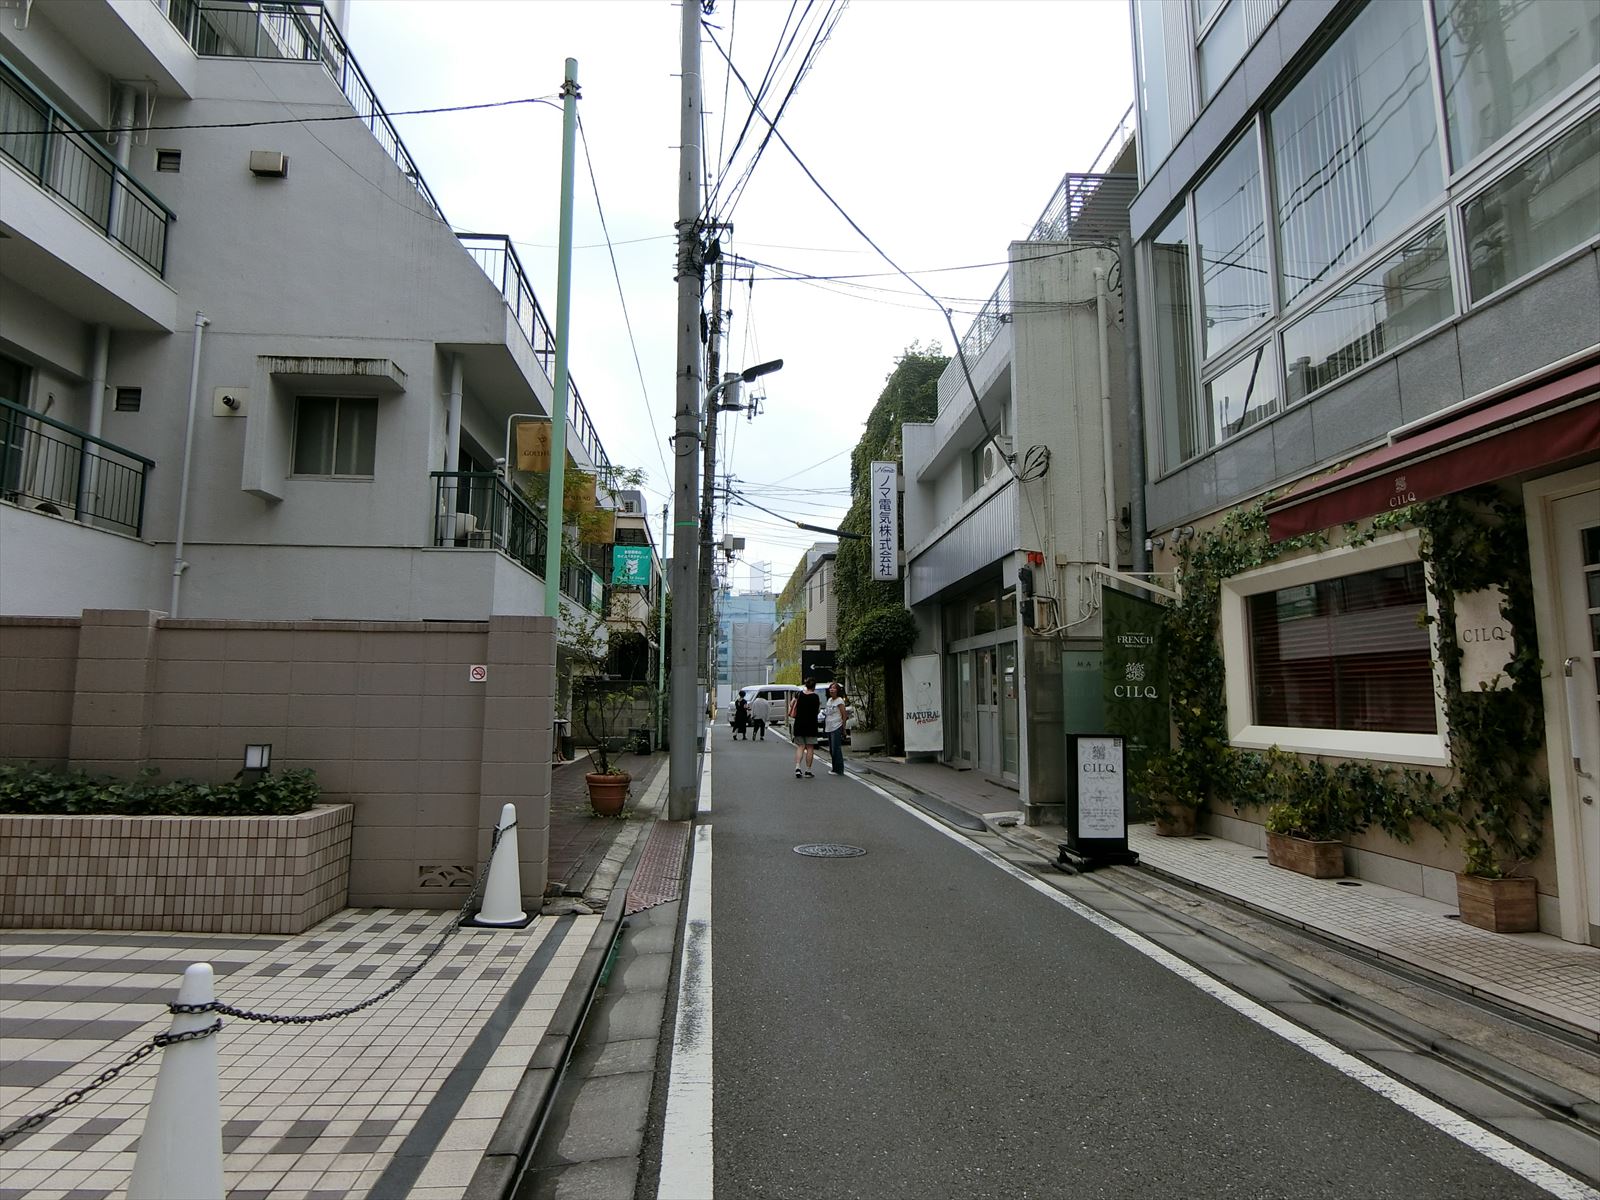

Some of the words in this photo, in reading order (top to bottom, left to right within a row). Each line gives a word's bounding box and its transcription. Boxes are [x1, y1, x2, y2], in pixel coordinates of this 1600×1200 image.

[1389, 491, 1417, 507] CILQ
[879, 475, 892, 577] ノマ電気株式会社
[1117, 635, 1154, 645] FRENCH
[1463, 626, 1506, 643] CILQ
[1114, 685, 1158, 699] CILQ
[906, 710, 940, 720] NATURAL
[1083, 763, 1116, 773] CILQ
